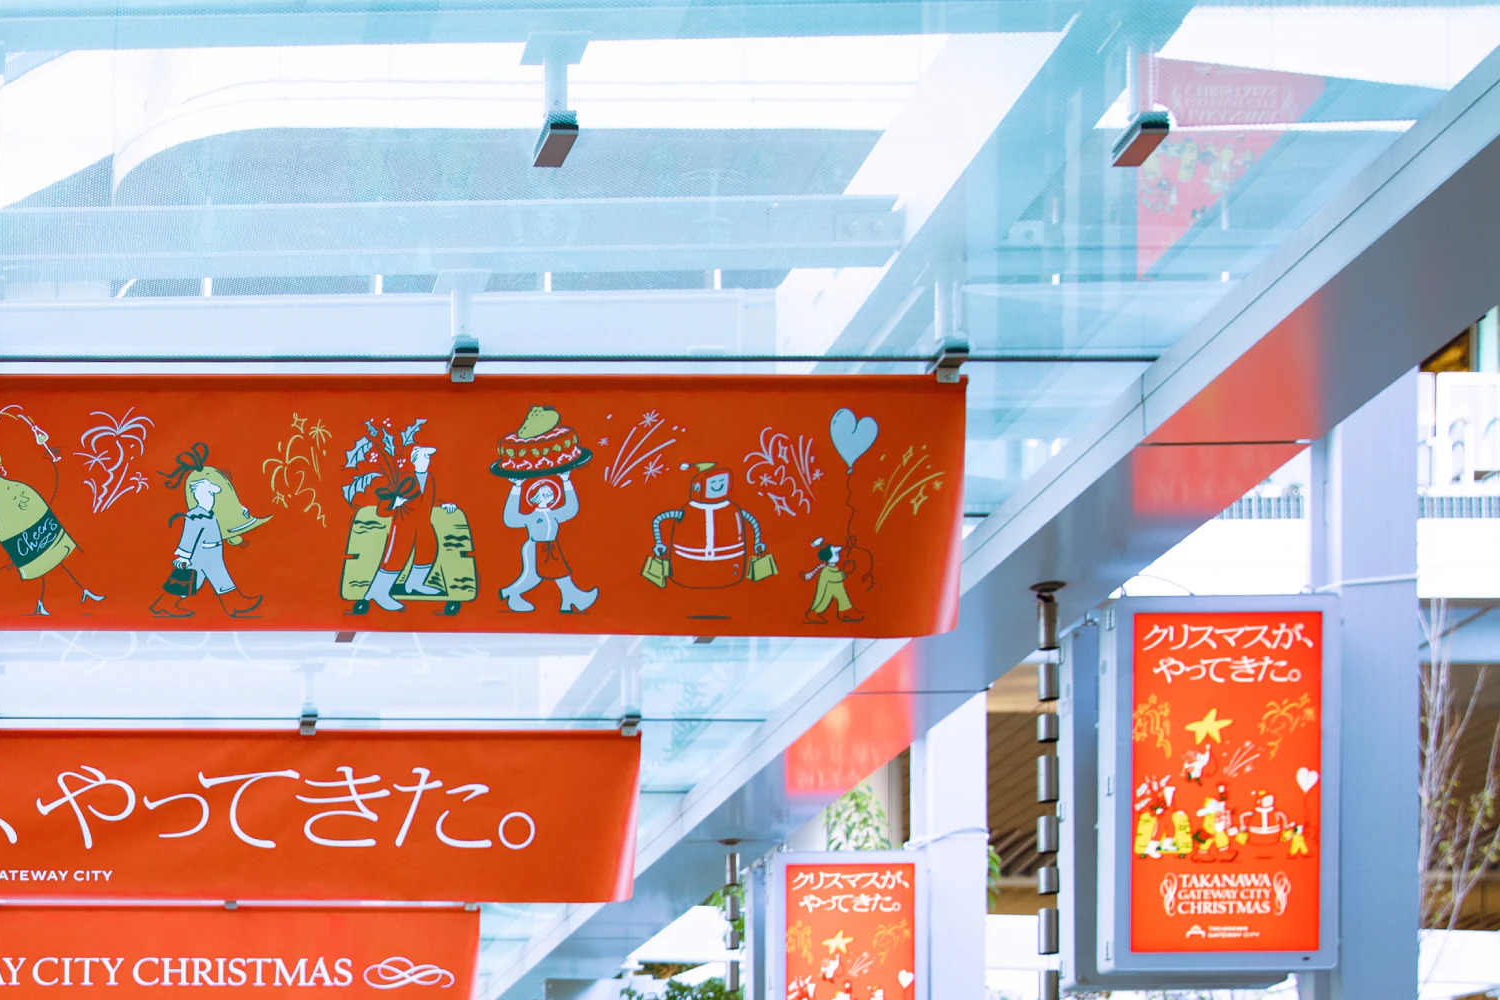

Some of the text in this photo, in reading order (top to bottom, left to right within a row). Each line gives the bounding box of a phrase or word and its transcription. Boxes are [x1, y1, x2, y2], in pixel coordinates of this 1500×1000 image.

[17, 517, 58, 556] Cheers
[1143, 623, 1313, 650] クリスマスが、
[1153, 656, 1300, 683] やってきた。
[74, 870, 112, 881] CITY
[792, 871, 909, 890] クリスマスが、
[1179, 874, 1271, 887] TAKANAWA
[799, 894, 900, 913] やってきた。
[1178, 889, 1270, 899] GATEWAY CITY
[1177, 901, 1270, 914] CHRISTMAS
[33, 957, 124, 985] CITY
[133, 957, 352, 986] CHRISTMAS
